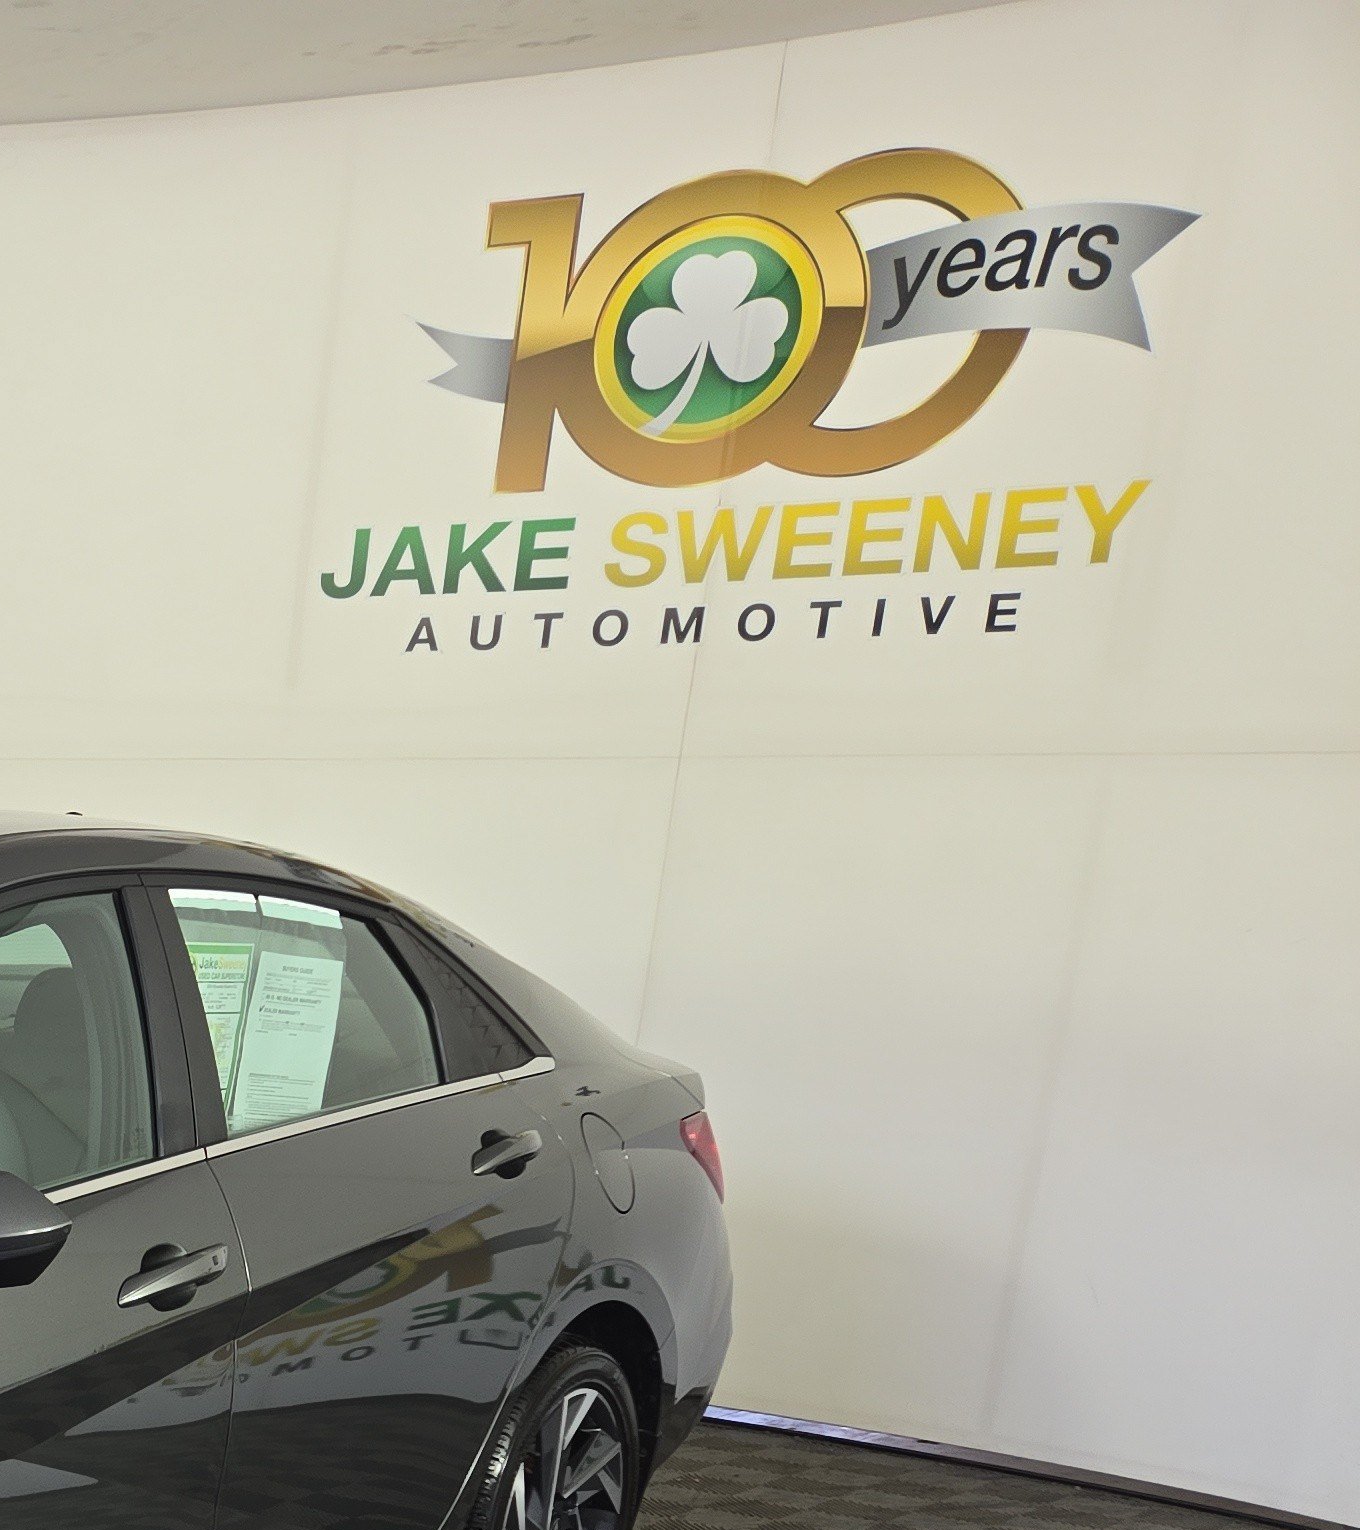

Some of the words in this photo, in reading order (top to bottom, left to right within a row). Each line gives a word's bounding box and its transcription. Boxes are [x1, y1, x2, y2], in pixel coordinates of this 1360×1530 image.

[882, 223, 1121, 330] years
[320, 516, 577, 600] JAKE
[603, 479, 1151, 589] SWEENEY
[405, 592, 1023, 655] AUTOMOTIVE
